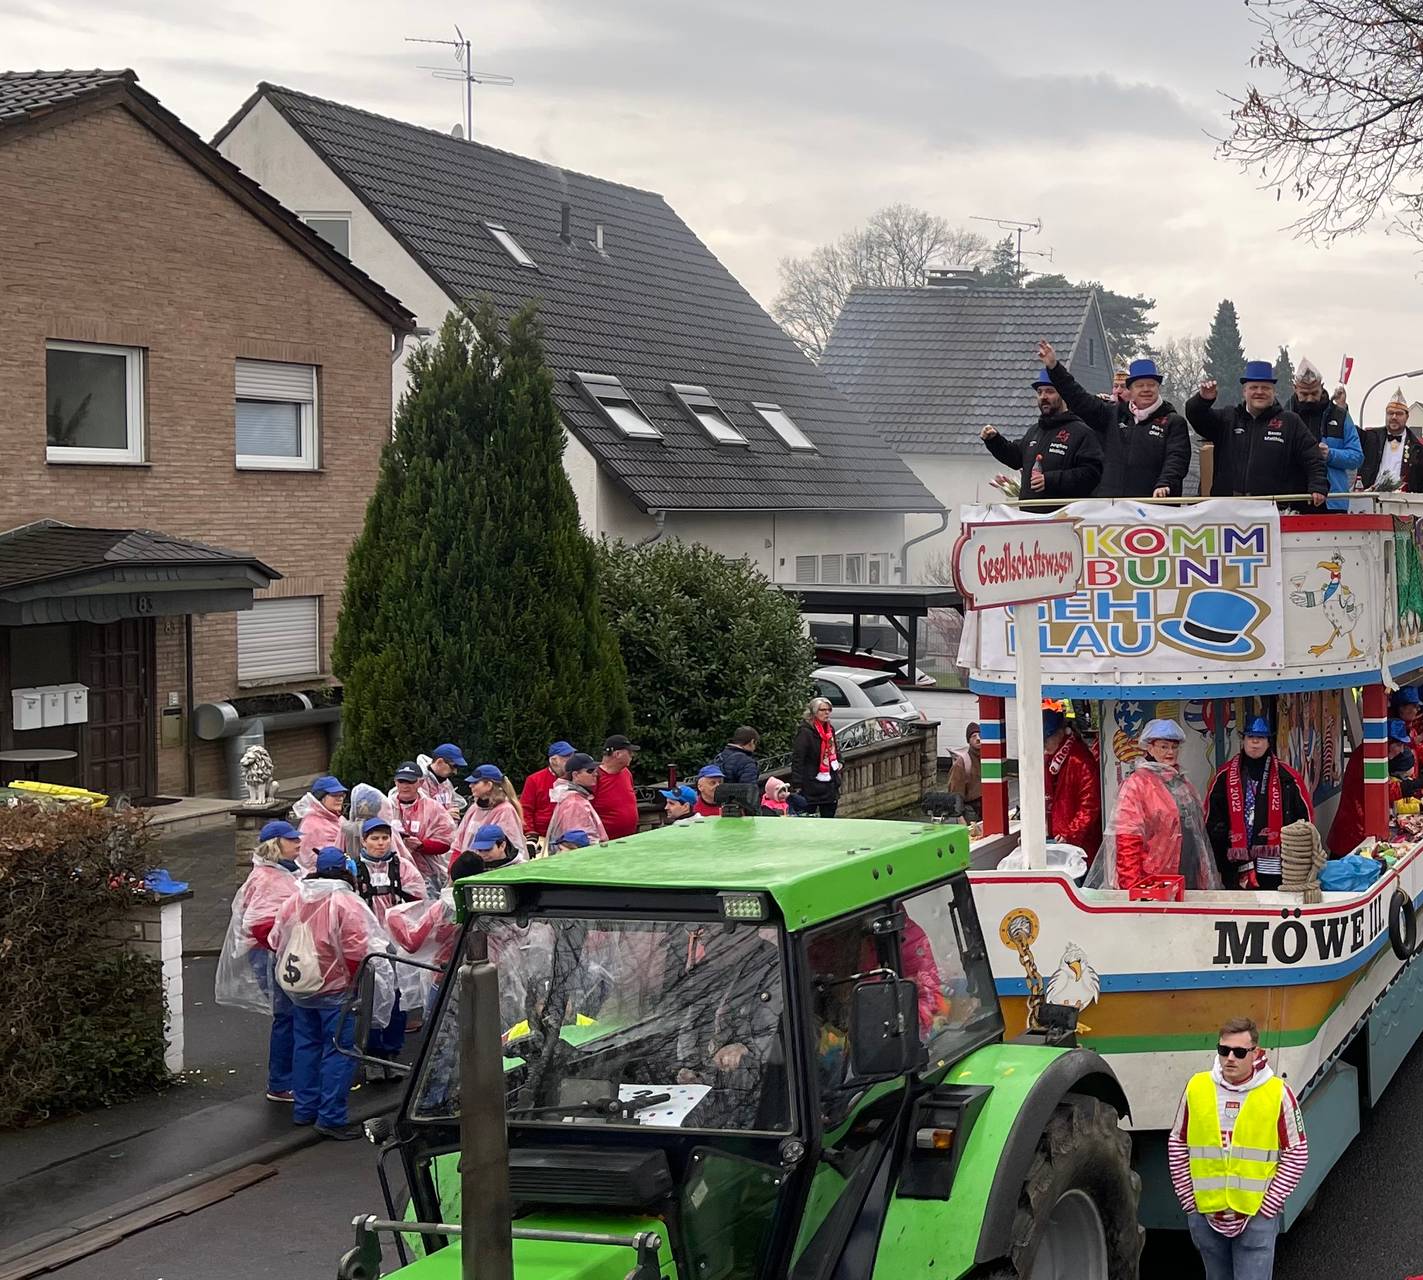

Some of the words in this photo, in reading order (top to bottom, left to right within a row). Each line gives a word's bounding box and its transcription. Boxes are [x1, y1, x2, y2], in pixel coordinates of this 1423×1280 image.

[1085, 525, 1265, 556] KOMM
[977, 540, 1074, 587] Gesellschaftswagen
[1086, 557, 1265, 586] BUNT
[1231, 787, 1242, 812] 2022
[1271, 786, 1280, 811] 2022
[1212, 907, 1364, 965] MÖWE
